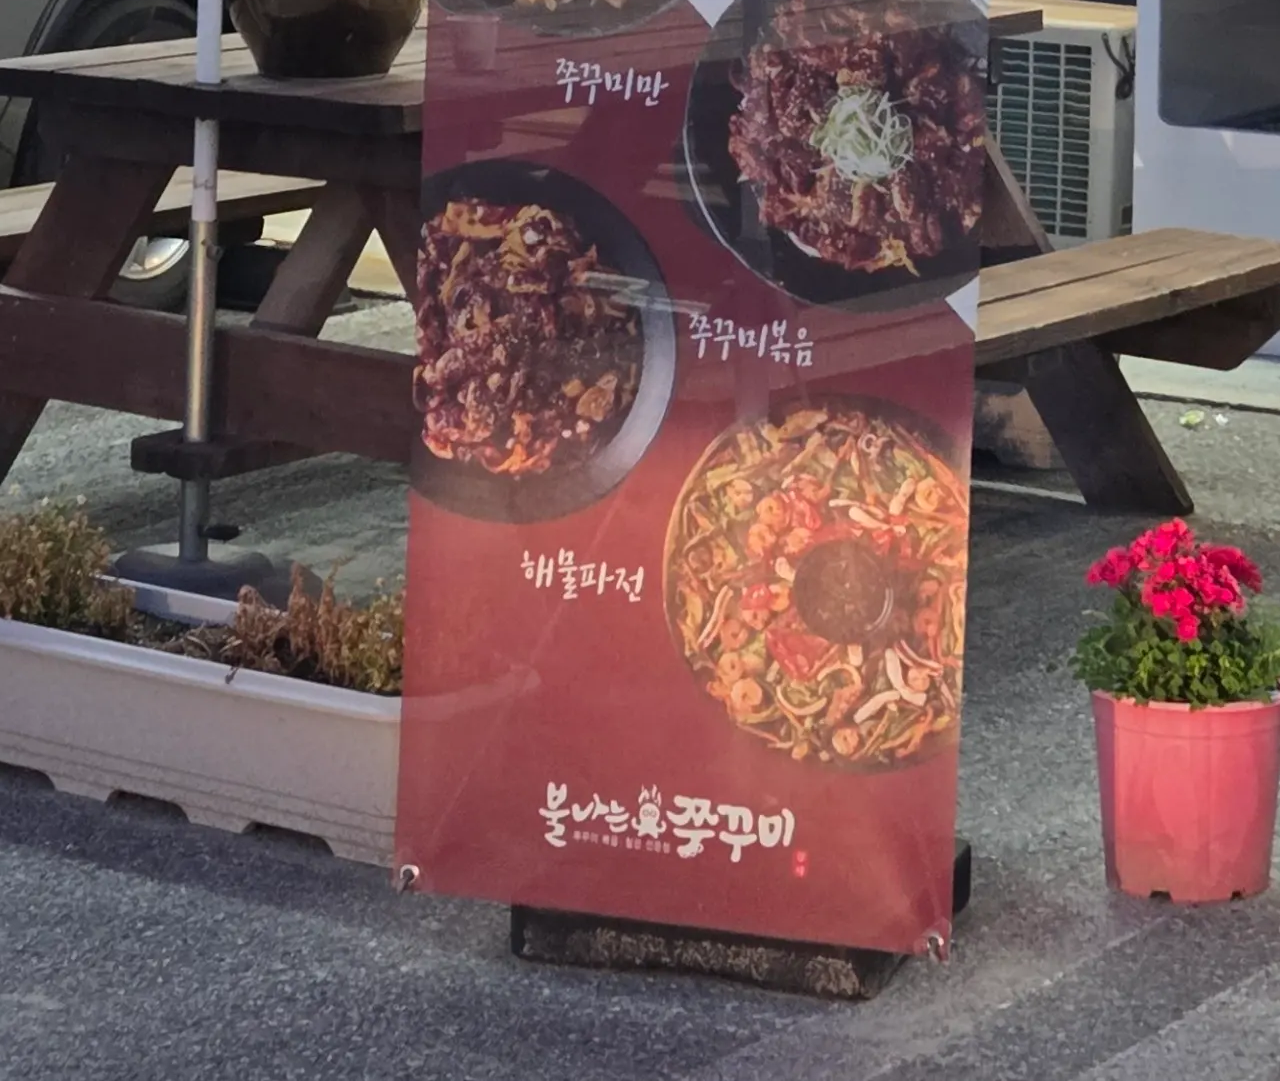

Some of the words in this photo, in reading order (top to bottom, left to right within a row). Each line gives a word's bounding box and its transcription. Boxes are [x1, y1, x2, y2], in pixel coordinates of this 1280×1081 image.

[555, 57, 669, 106] 쭈꾸미만
[688, 312, 815, 368] 쭈꾸미볶음
[520, 547, 646, 603] 해물파전
[539, 782, 629, 847] 불나는
